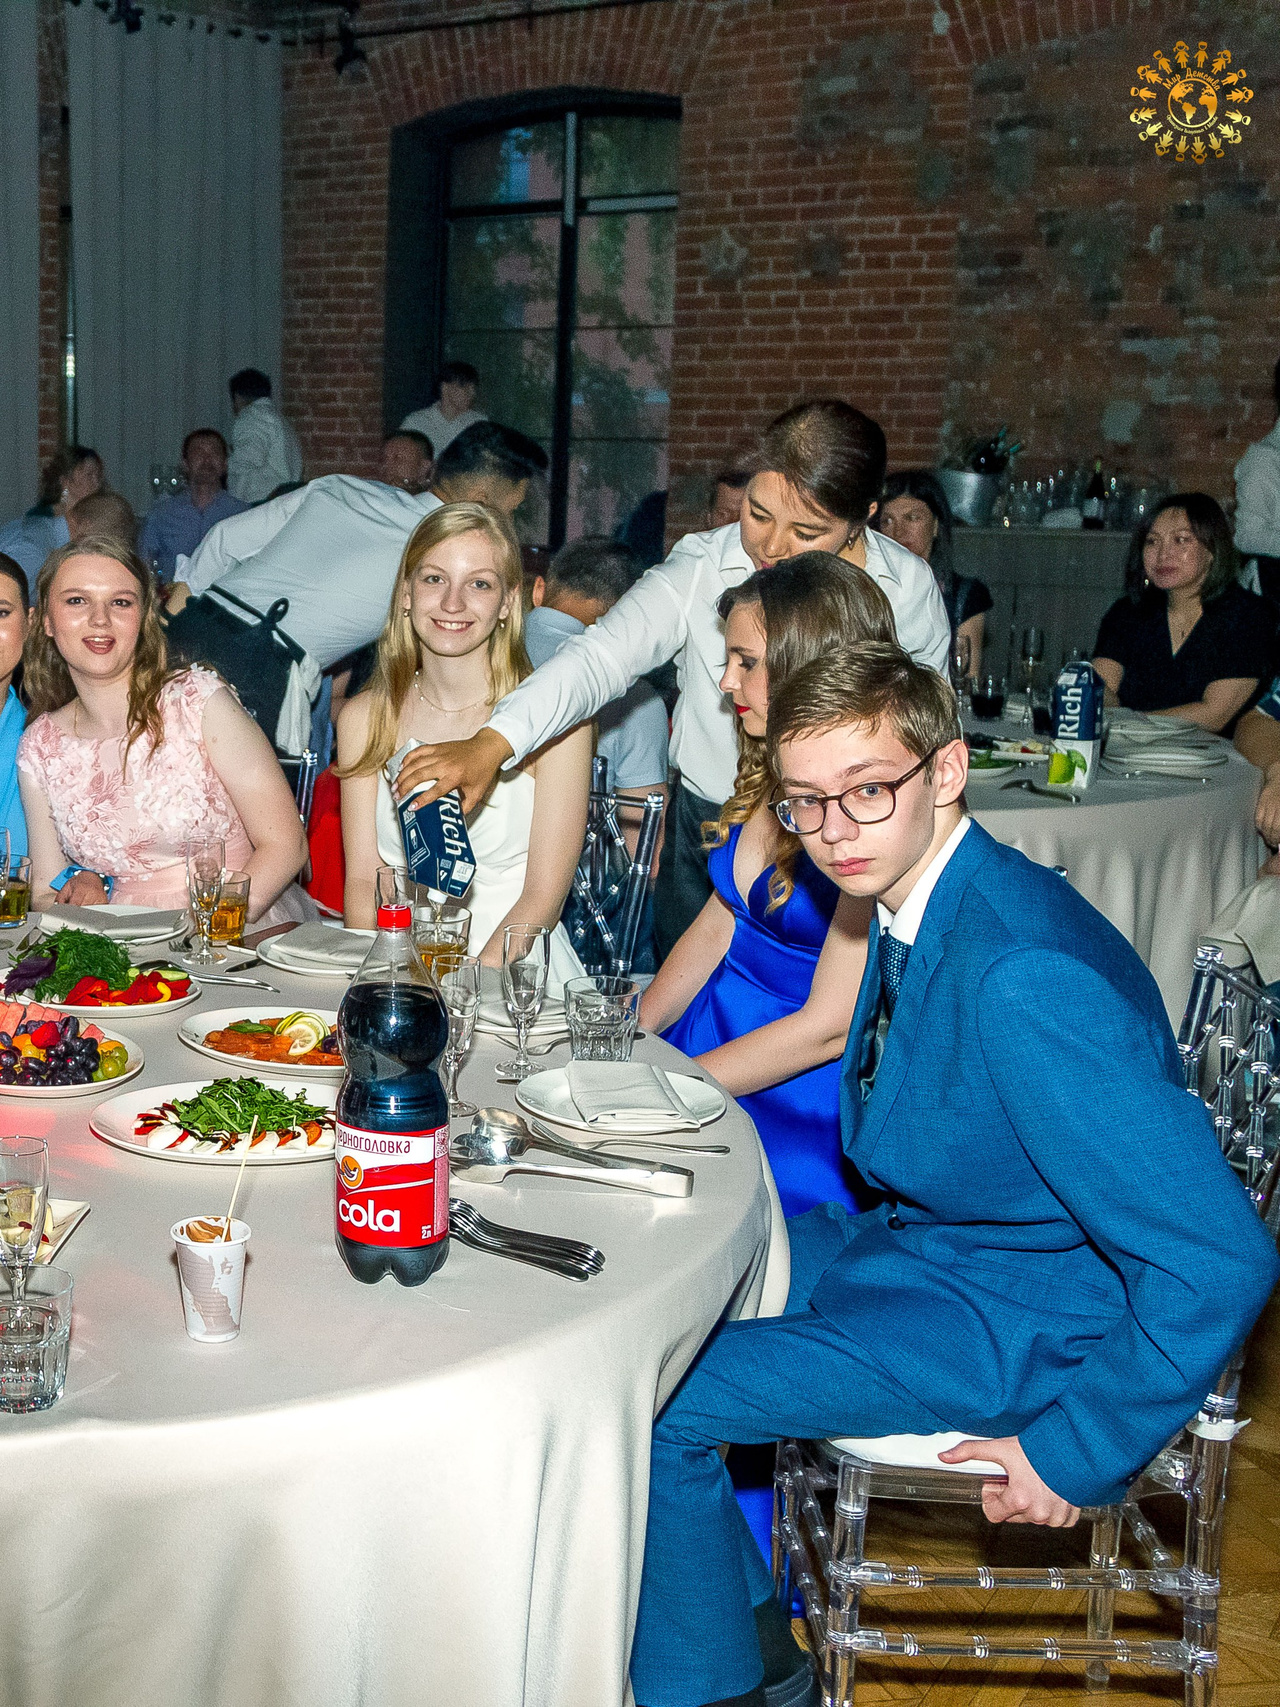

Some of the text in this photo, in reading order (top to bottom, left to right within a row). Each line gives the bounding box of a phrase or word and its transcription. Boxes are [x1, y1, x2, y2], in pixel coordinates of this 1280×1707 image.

[1057, 687, 1083, 739] Rich
[437, 797, 468, 856] Rich
[338, 1199, 401, 1232] cola
